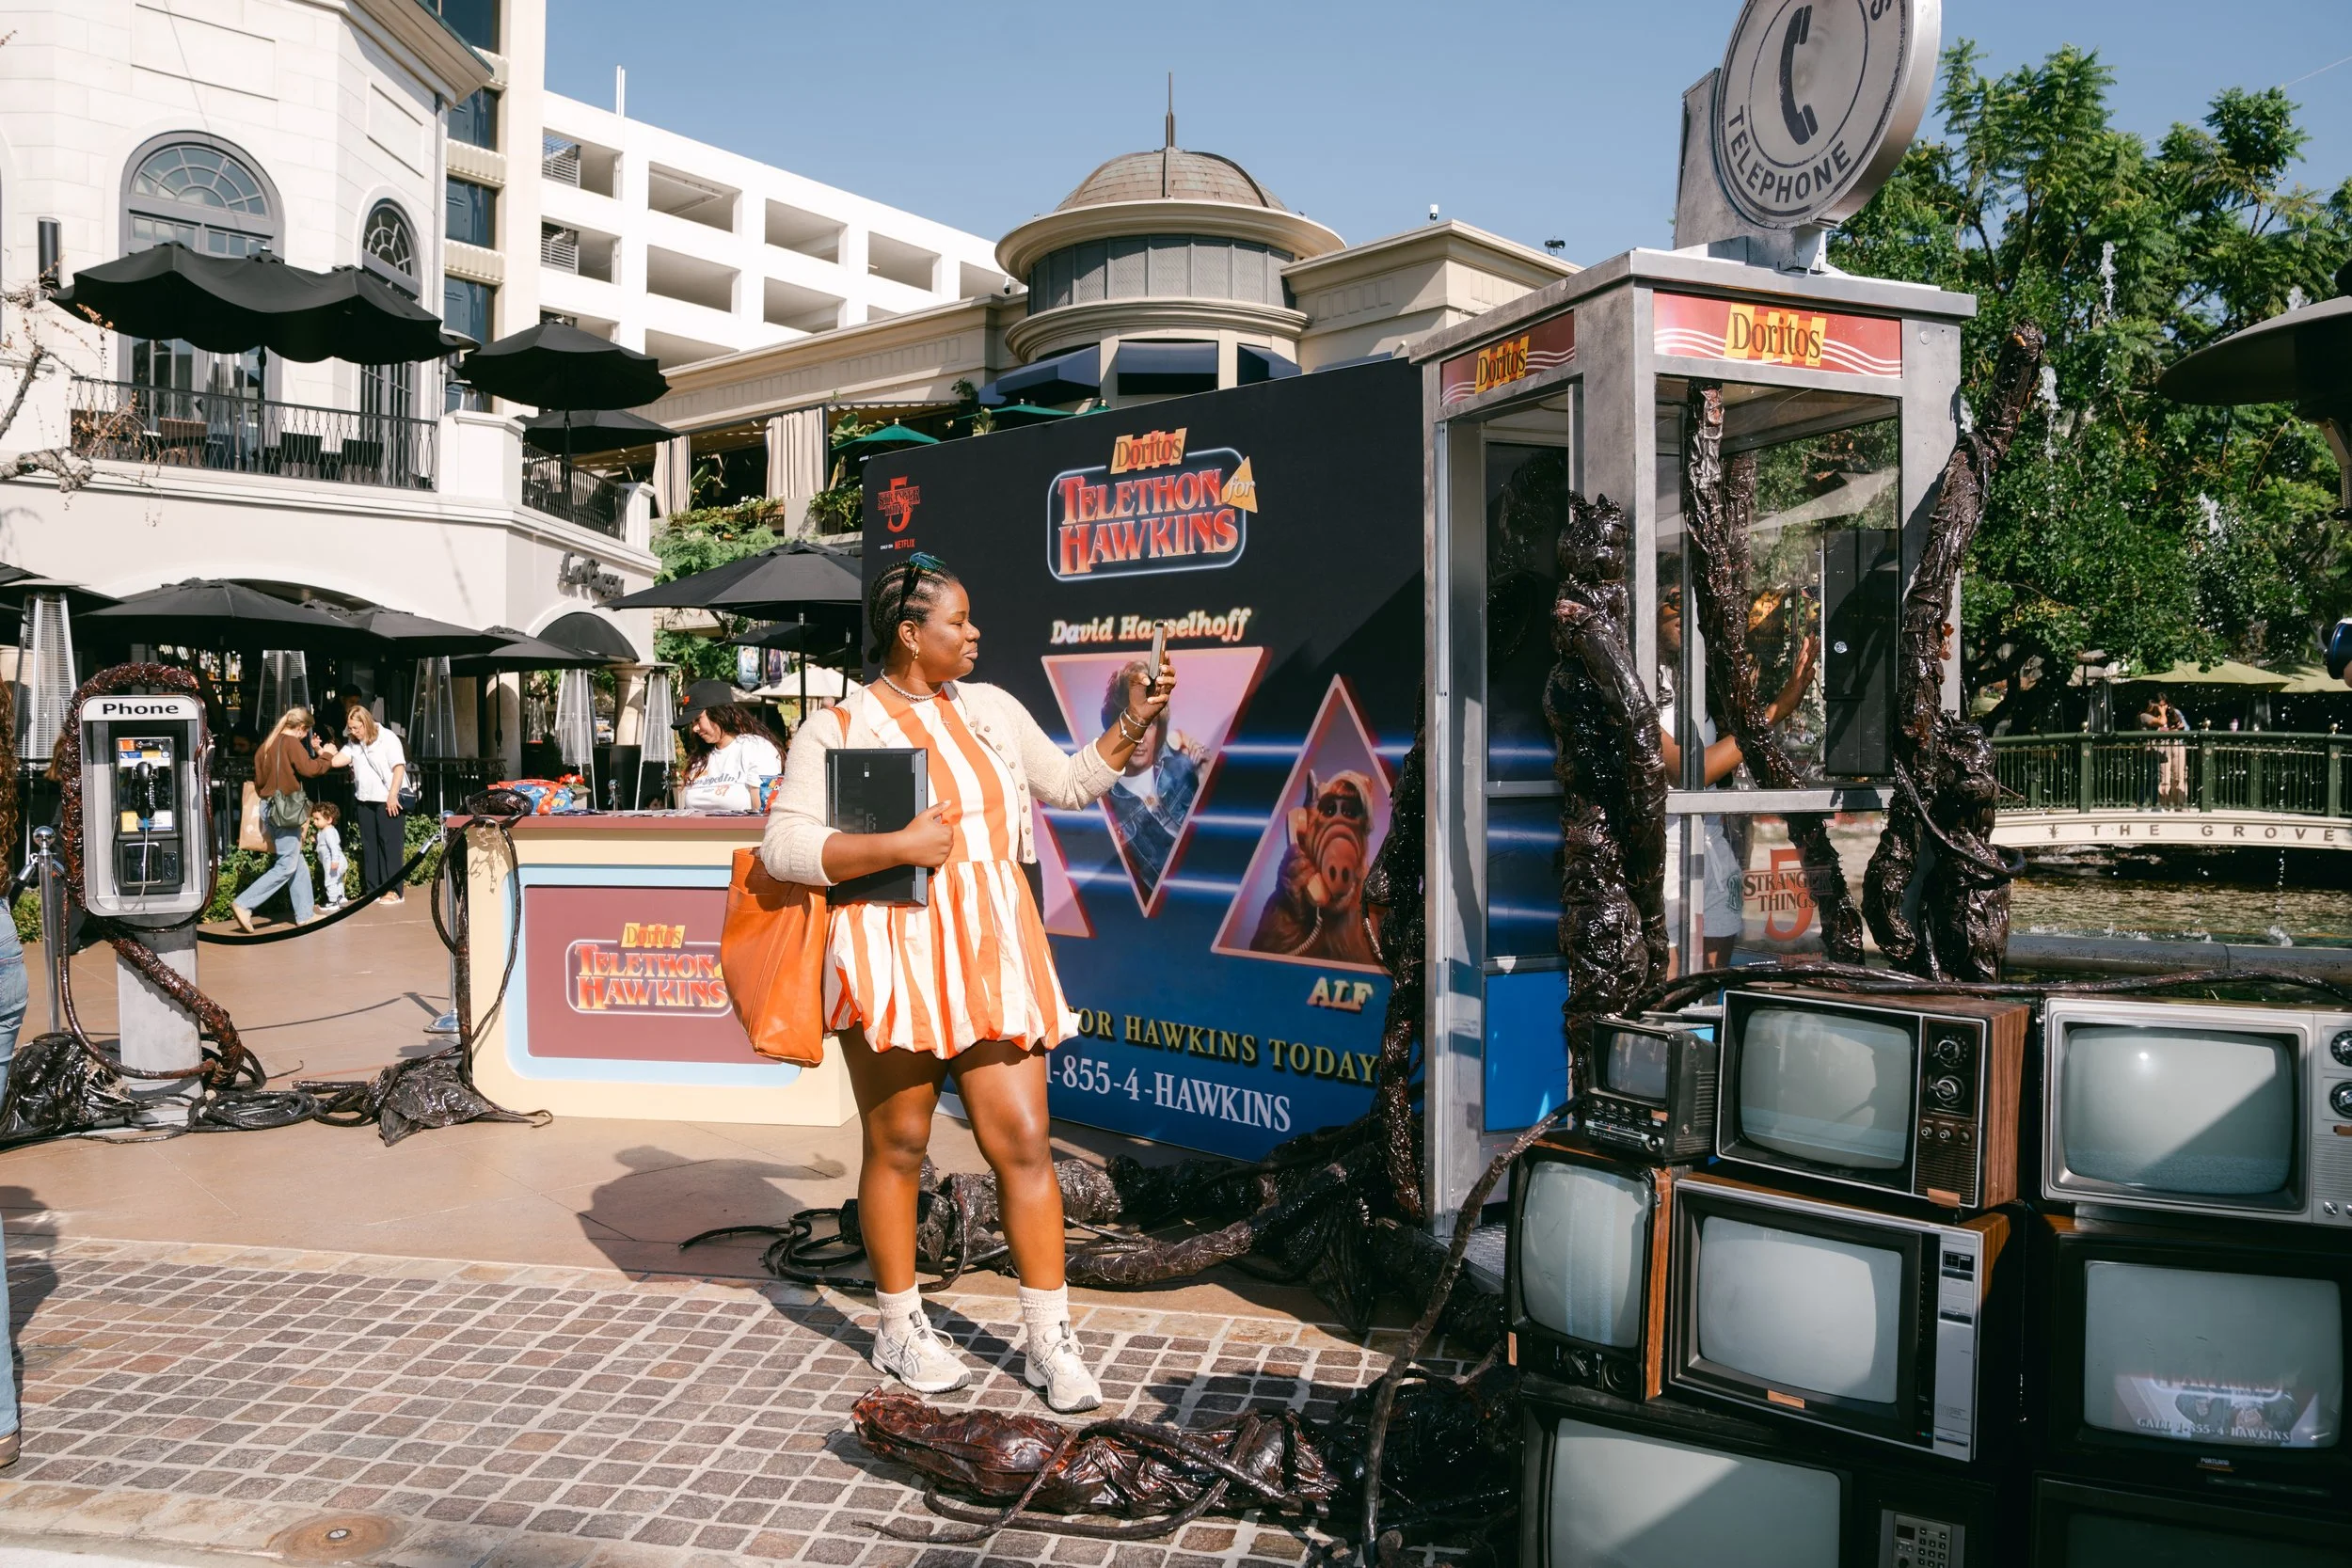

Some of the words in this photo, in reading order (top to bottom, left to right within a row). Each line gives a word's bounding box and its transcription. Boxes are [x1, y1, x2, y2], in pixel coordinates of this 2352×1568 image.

[1728, 104, 1851, 203] TELEPHONE
[1731, 312, 1820, 358] Doritos
[1479, 348, 1526, 387] Doritos
[1116, 436, 1182, 468] Doritos
[1058, 468, 1222, 525] TELETHON
[1226, 474, 1255, 503] for
[894, 538, 915, 549] NETFLIX
[1058, 508, 1238, 576] HAWKINS
[1050, 617, 1113, 643] David
[1119, 608, 1251, 641] Haselhoff
[103, 703, 179, 715] Phone
[2091, 824, 2160, 836] THE
[2201, 824, 2335, 842] GROVE
[1743, 869, 1835, 897] STRANGER
[1757, 893, 1820, 912] THINGS
[626, 925, 682, 946] Doritos
[575, 943, 716, 979] TELETHON
[575, 975, 729, 1010] HAWKINS
[1306, 976, 1374, 1011] ALF
[1069, 1006, 1113, 1037] OR
[1124, 1014, 1257, 1062] HAWKINS
[1269, 1038, 1379, 1083] TODAY
